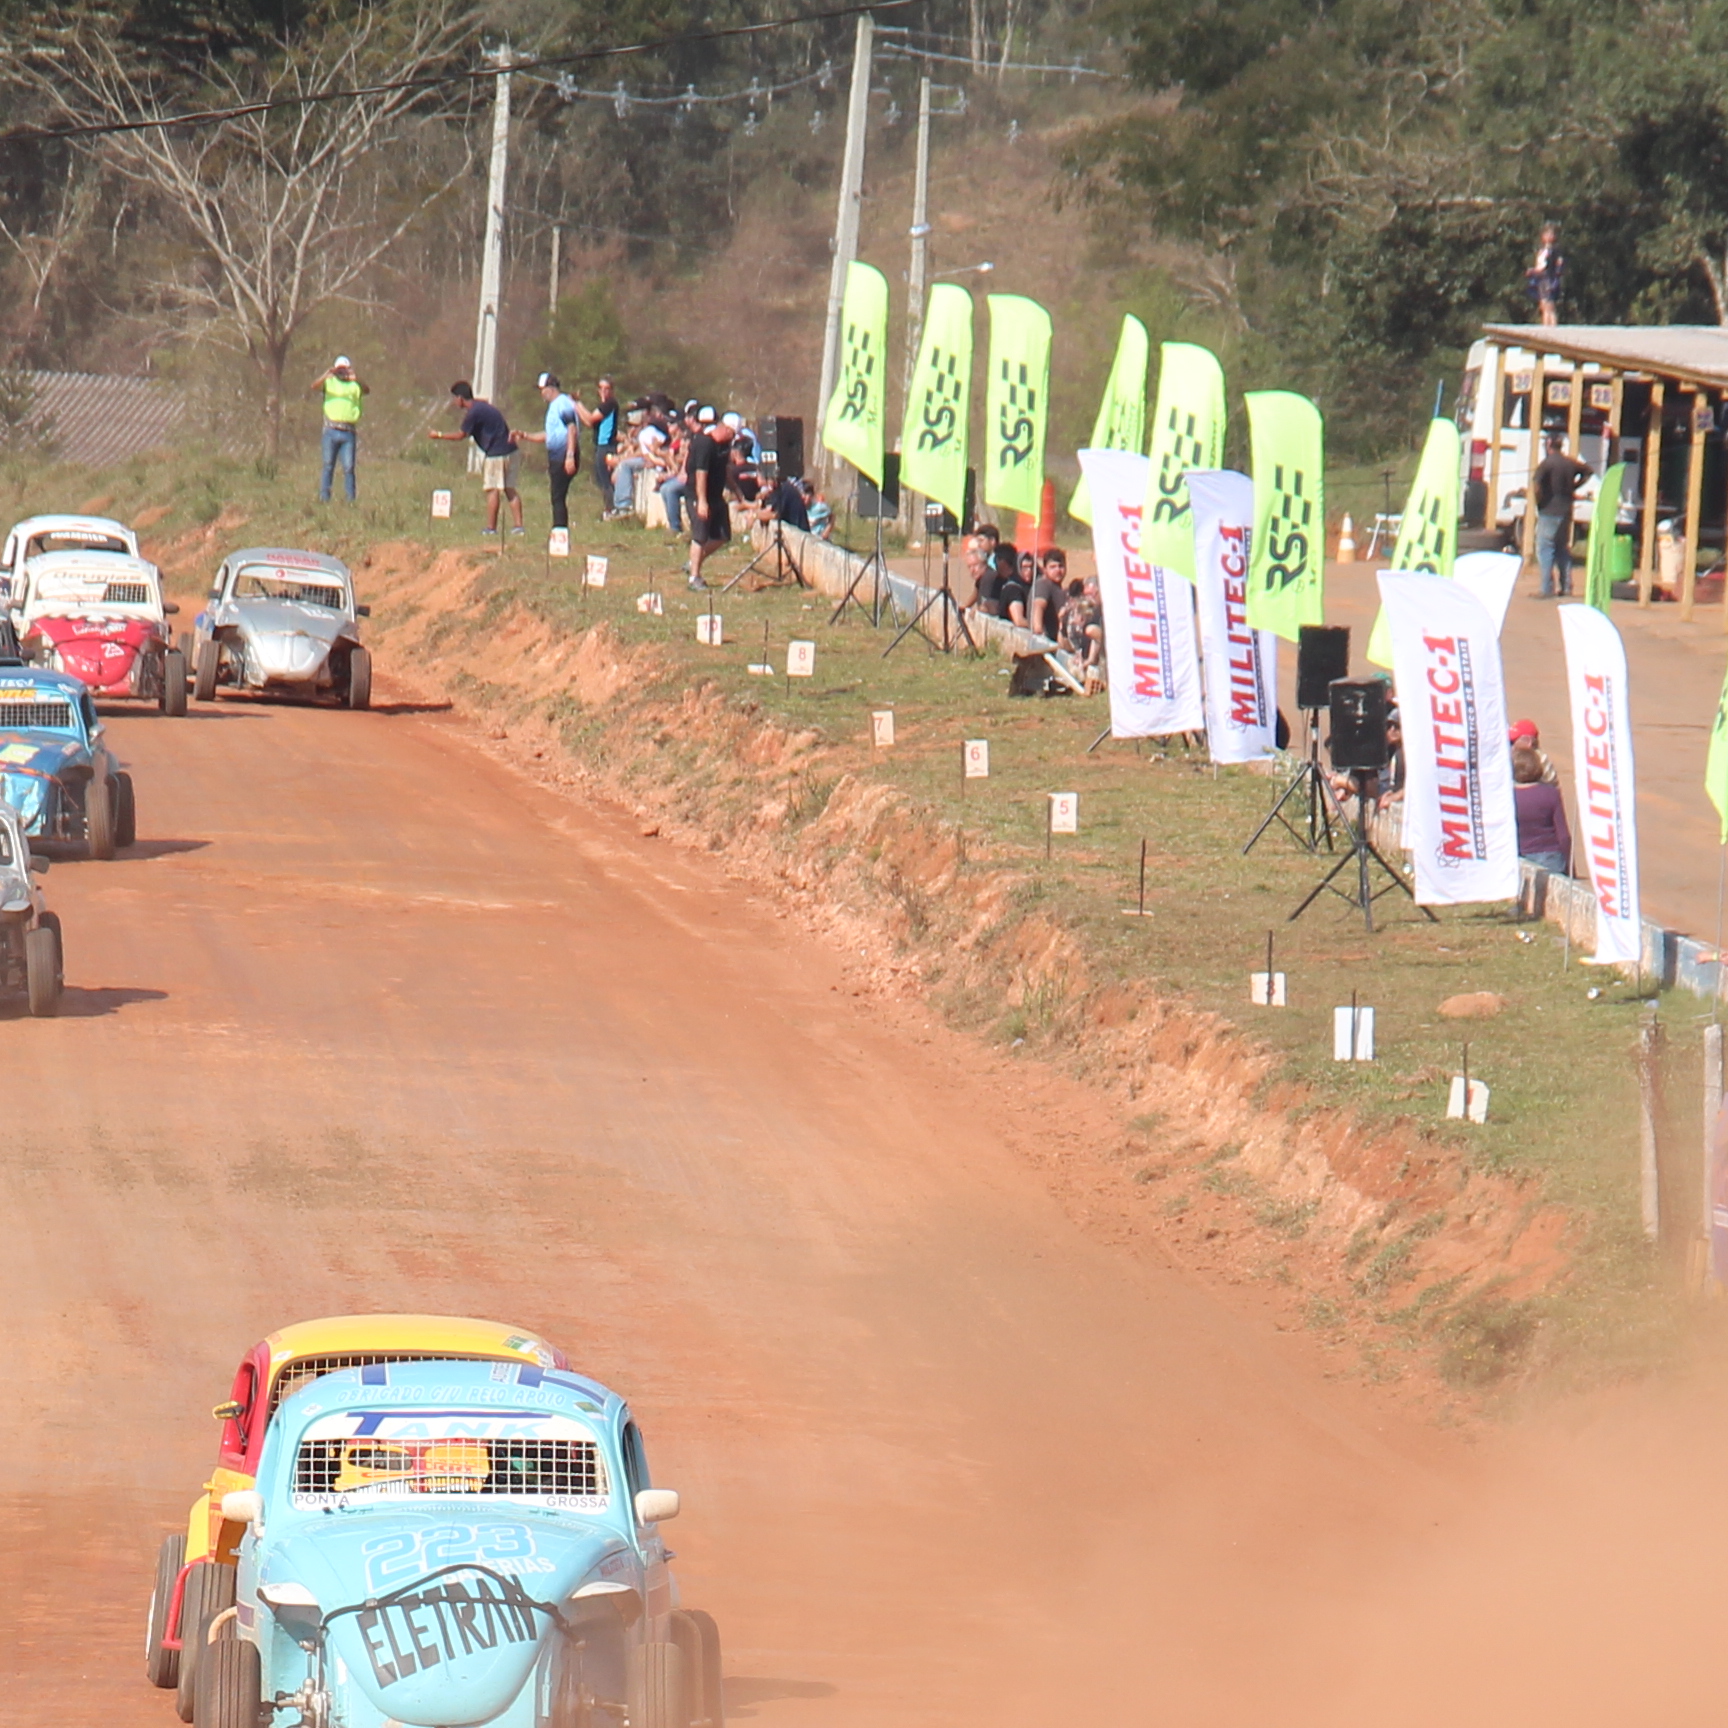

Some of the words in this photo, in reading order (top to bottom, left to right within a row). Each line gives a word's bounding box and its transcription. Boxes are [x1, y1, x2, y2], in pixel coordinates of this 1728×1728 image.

[433, 494, 449, 507] 15
[587, 561, 605, 575] 12
[1219, 524, 1258, 727] MILITEC-1
[798, 647, 807, 661] 8
[873, 716, 884, 731] 7
[970, 746, 980, 761] 6
[1423, 634, 1474, 861] MILITEC-1
[1584, 672, 1619, 918] MILITEC-1
[1060, 800, 1070, 815] 5
[345, 1411, 553, 1437] TANK
[294, 1493, 351, 1506] PONTA
[545, 1495, 609, 1509] GROSSA
[361, 1522, 537, 1594] 223
[355, 1573, 539, 1690] ELETRAN
